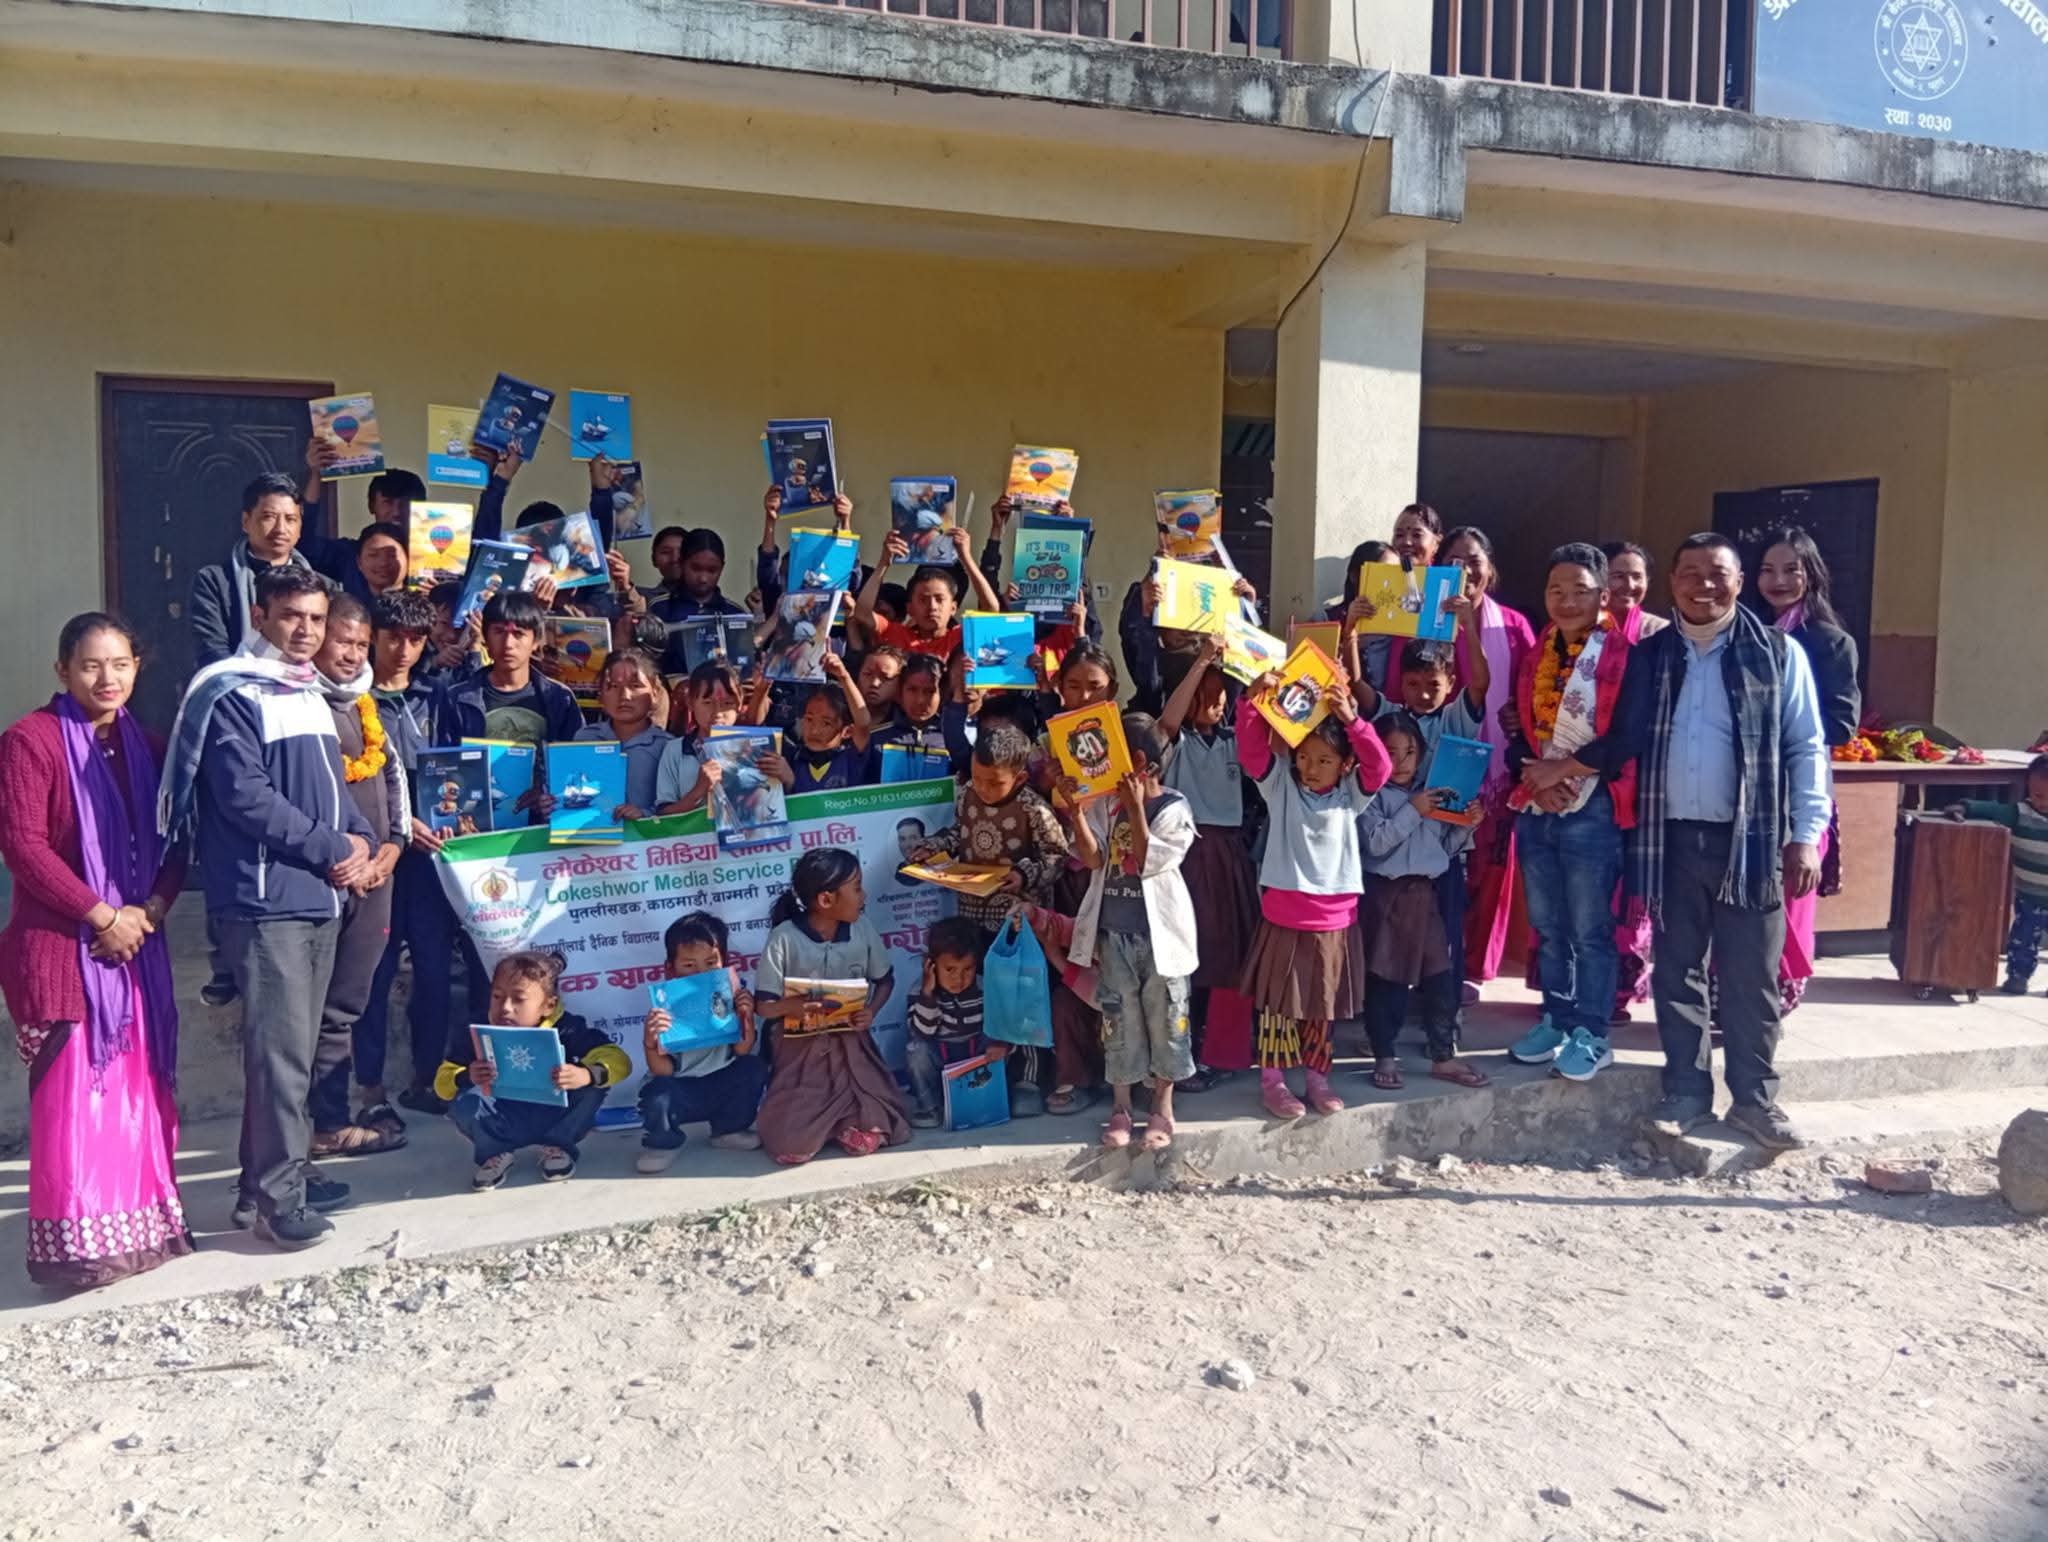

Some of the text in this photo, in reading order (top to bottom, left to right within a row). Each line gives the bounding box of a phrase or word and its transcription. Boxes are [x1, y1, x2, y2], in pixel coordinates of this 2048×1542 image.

[1917, 113, 1952, 132] २०३०
[1282, 685, 1310, 717] UP
[541, 852, 639, 882] लोकेश्वर
[646, 842, 718, 869] मिडिया
[545, 879, 650, 905] Lokeshwor
[655, 869, 709, 892] Media
[713, 861, 785, 885] Service
